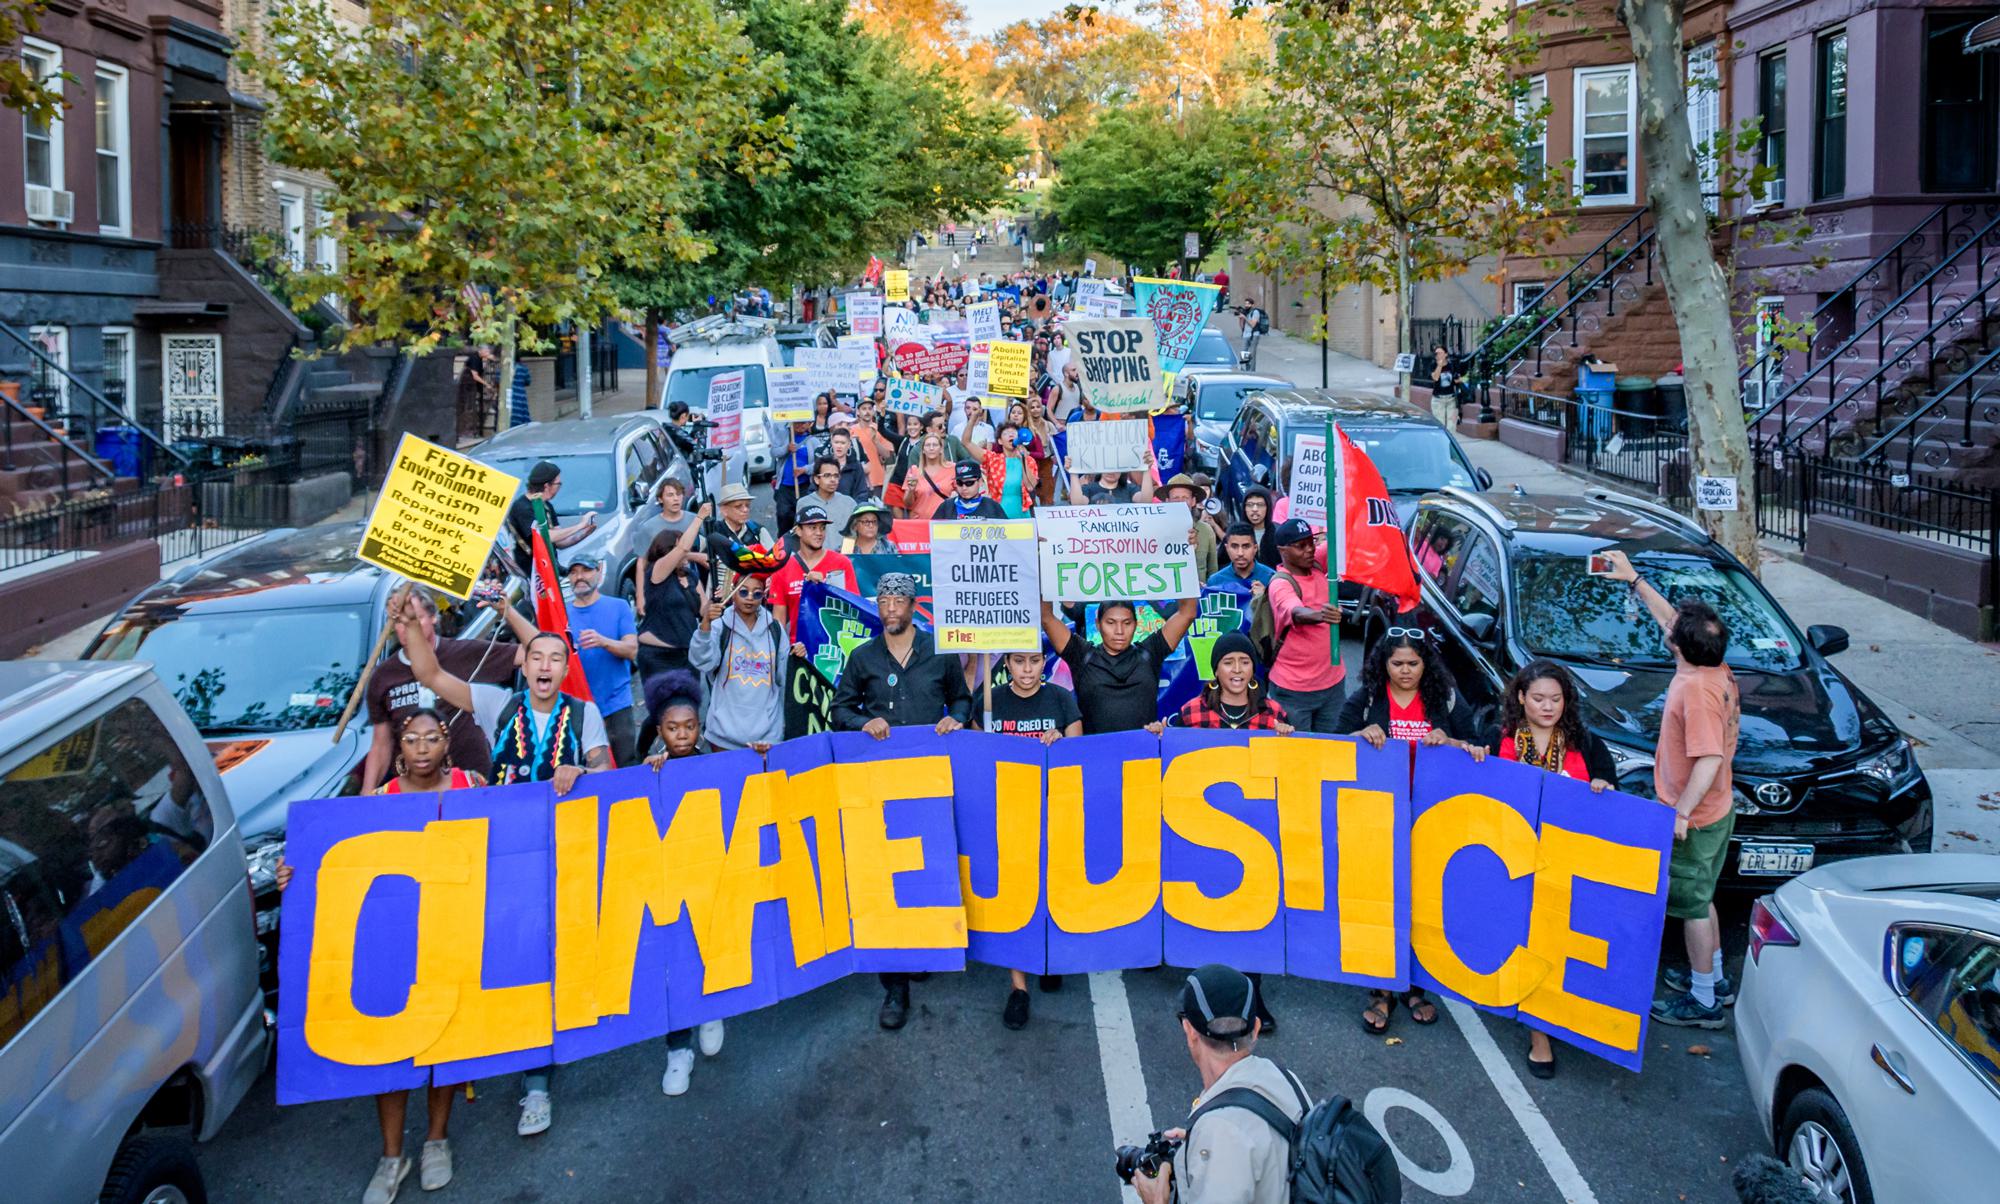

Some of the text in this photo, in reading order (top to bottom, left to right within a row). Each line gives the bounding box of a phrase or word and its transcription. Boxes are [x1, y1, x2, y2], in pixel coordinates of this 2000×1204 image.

[972, 306, 992, 316] MELT
[993, 346, 1026, 355] Abolish
[1077, 330, 1144, 354] STOP
[995, 368, 1026, 377] Climate
[1082, 355, 1151, 384] SHOPPING
[889, 378, 938, 396] PLANET
[1080, 446, 1141, 470] KILLS
[1303, 448, 1327, 462] ABO
[425, 448, 488, 484] Fight
[400, 455, 506, 508] Environmental
[1298, 481, 1323, 494] SHUT
[411, 480, 480, 516] Racism
[1296, 494, 1314, 507] BIG
[391, 490, 484, 533] Reparations
[1047, 506, 1166, 520] ILLEGAL CATTLE
[399, 508, 468, 544] for Black,
[960, 526, 1007, 540] BIG OIL
[1080, 520, 1140, 533] RANCHING
[391, 520, 461, 556] Brown, &
[900, 542, 931, 551] NEW YO
[1052, 536, 1190, 556] IS DESTROYING OUR
[371, 527, 475, 577] Native People
[970, 544, 998, 563] PAY
[952, 564, 1018, 583] CLIMATE
[1056, 562, 1188, 598] FOREST
[955, 591, 1019, 606] REFUGEES
[945, 608, 1030, 624] REPARATIONS
[992, 718, 1056, 732] YO NO CREO EN
[304, 737, 1661, 1066] CLIMATE JUSTICE
